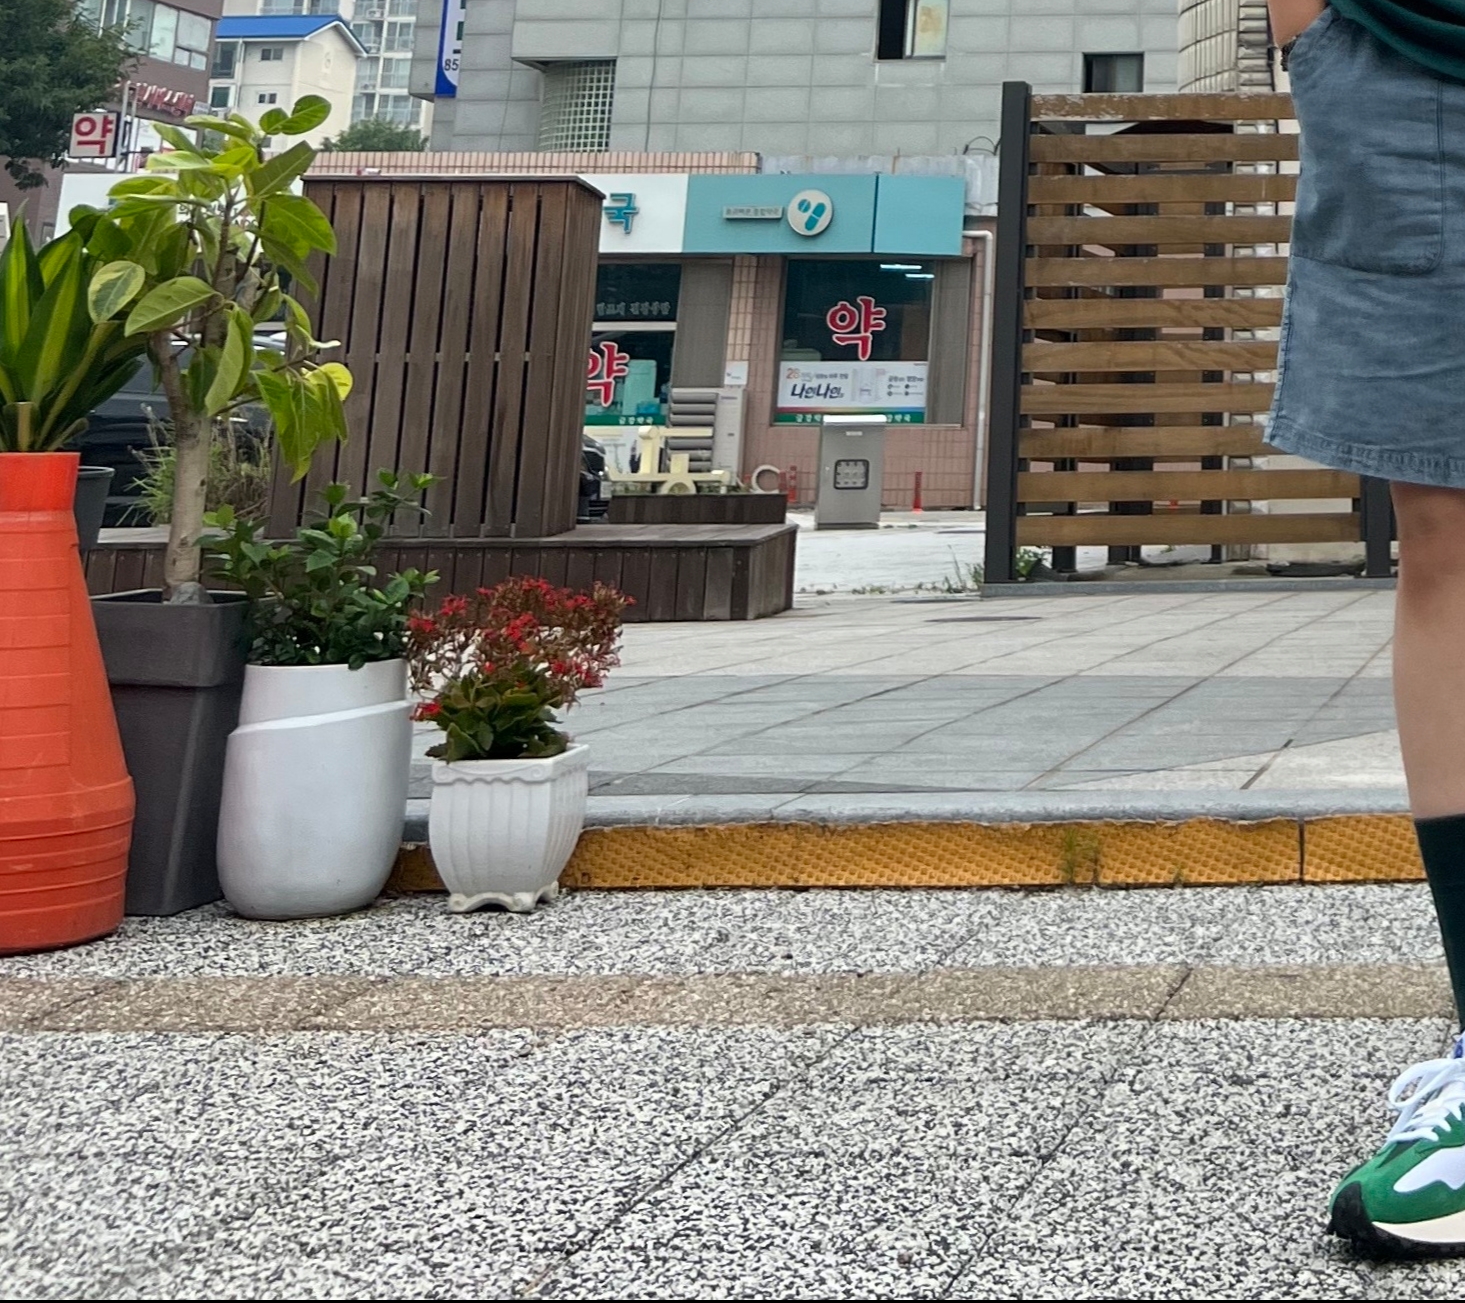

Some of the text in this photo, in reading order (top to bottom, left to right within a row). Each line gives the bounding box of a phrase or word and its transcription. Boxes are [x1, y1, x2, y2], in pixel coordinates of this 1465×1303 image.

[75, 115, 114, 155] 약
[603, 192, 640, 235] 국
[826, 296, 887, 362] 약
[587, 341, 631, 407] 약
